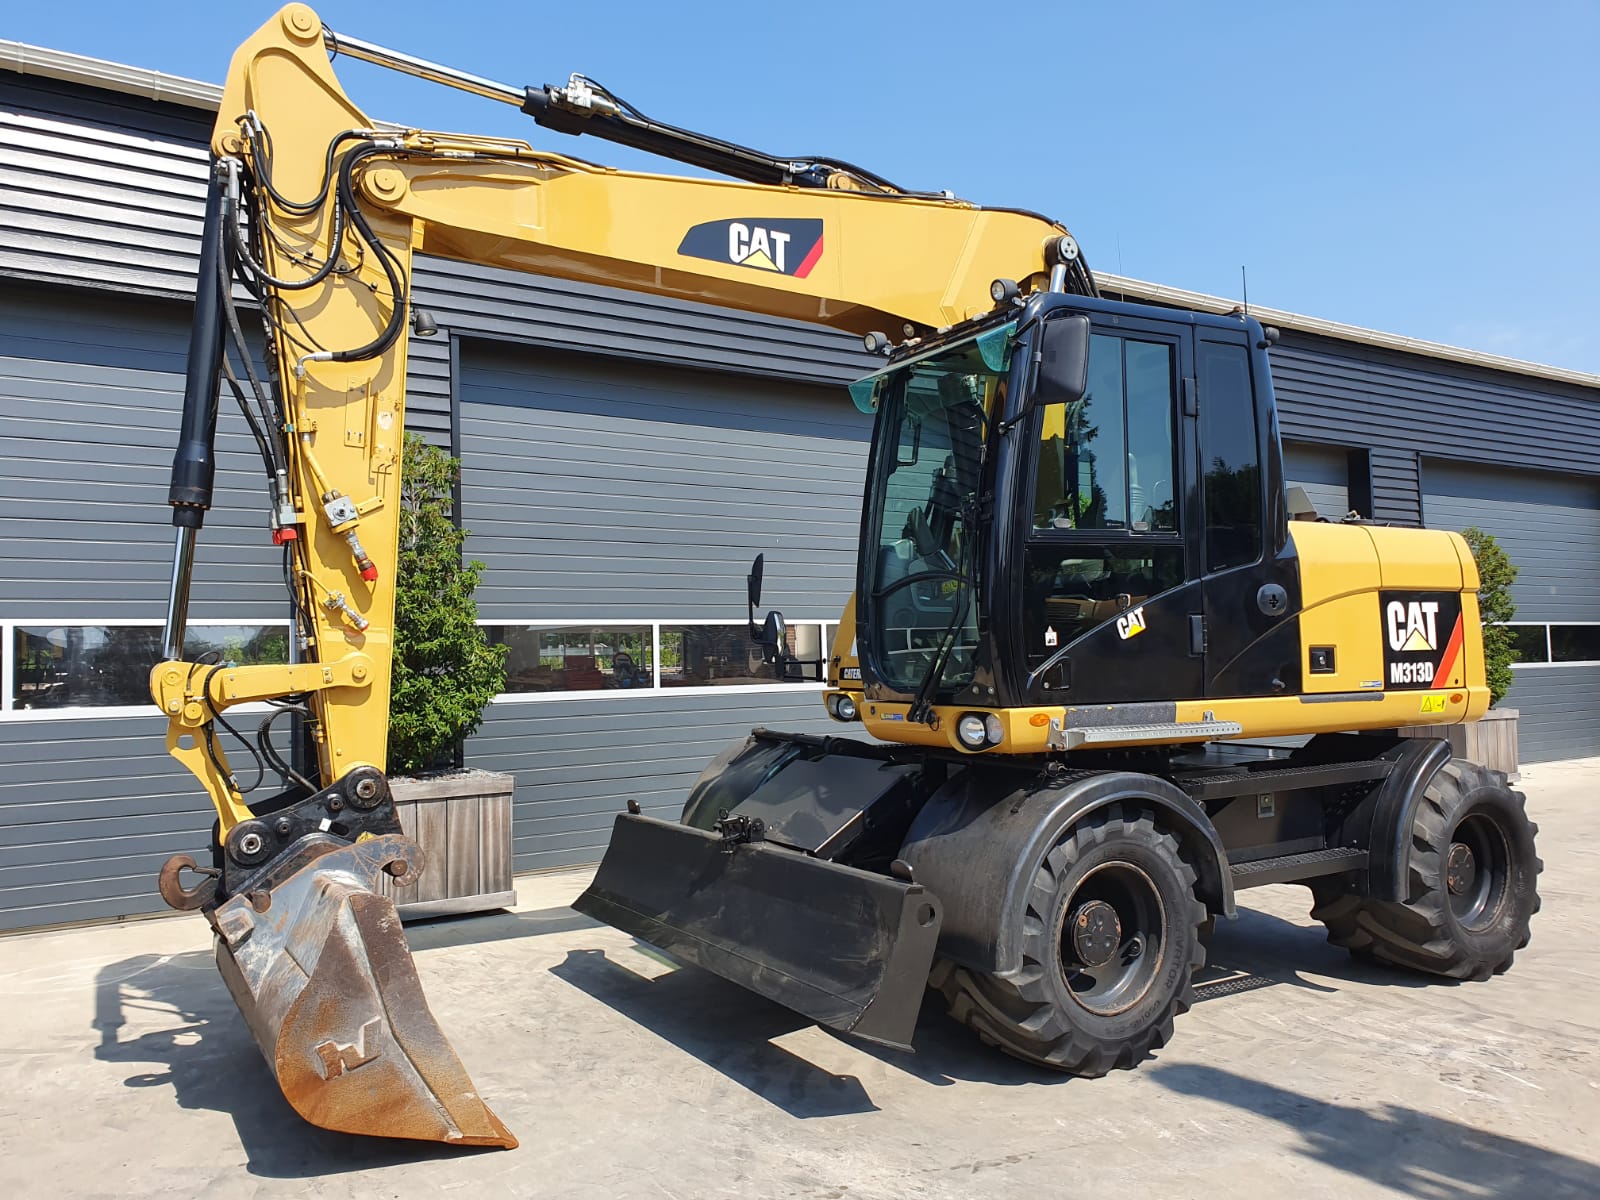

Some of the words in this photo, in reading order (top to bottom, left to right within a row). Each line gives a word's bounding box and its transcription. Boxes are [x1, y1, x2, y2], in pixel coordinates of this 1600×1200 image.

[729, 222, 790, 272] CAT
[1117, 606, 1147, 640] CAT
[1387, 601, 1439, 652] CAT
[1390, 662, 1434, 684] M313D
